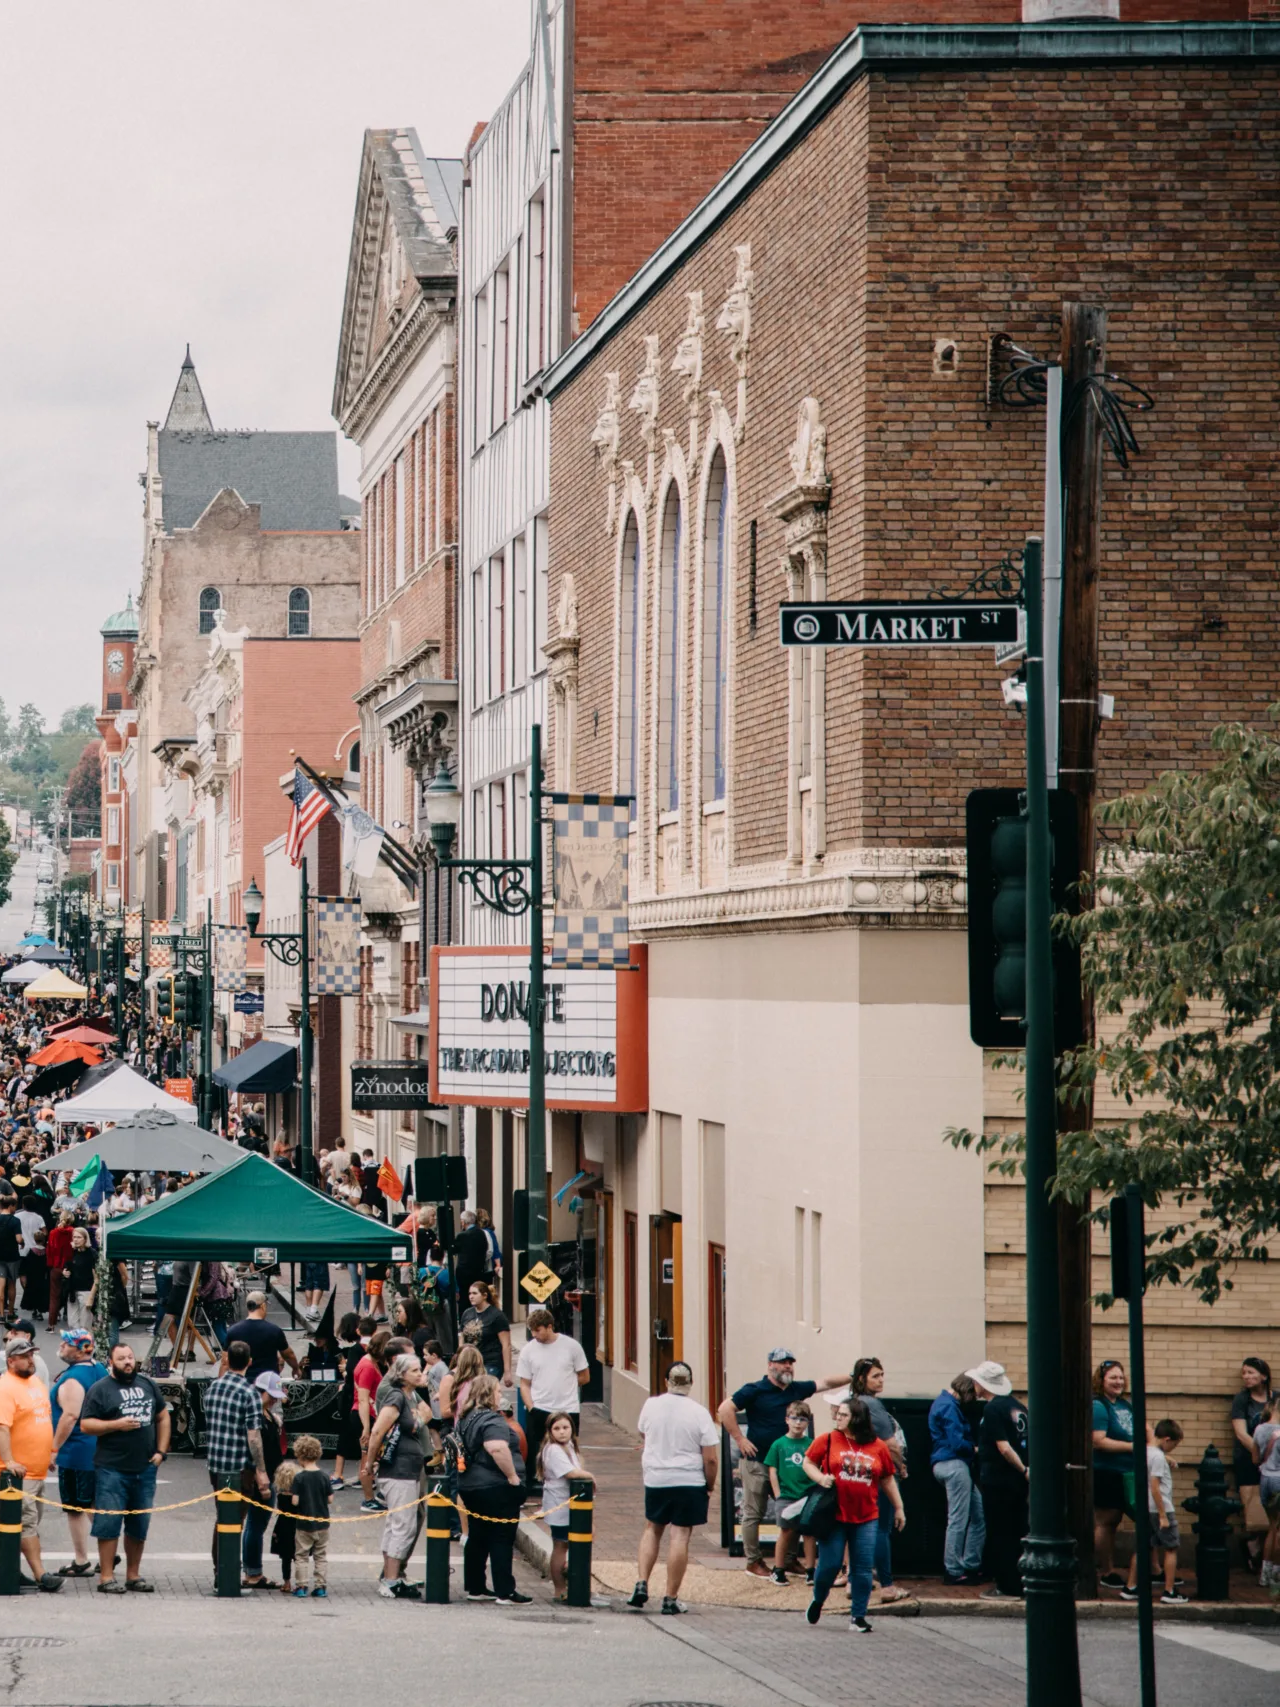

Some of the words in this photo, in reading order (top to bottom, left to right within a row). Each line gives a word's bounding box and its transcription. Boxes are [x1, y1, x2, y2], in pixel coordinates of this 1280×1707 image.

[835, 613, 966, 640] MARKET
[981, 611, 1001, 624] ST
[481, 981, 566, 1023] DONTE
[120, 1387, 144, 1401] DAD
